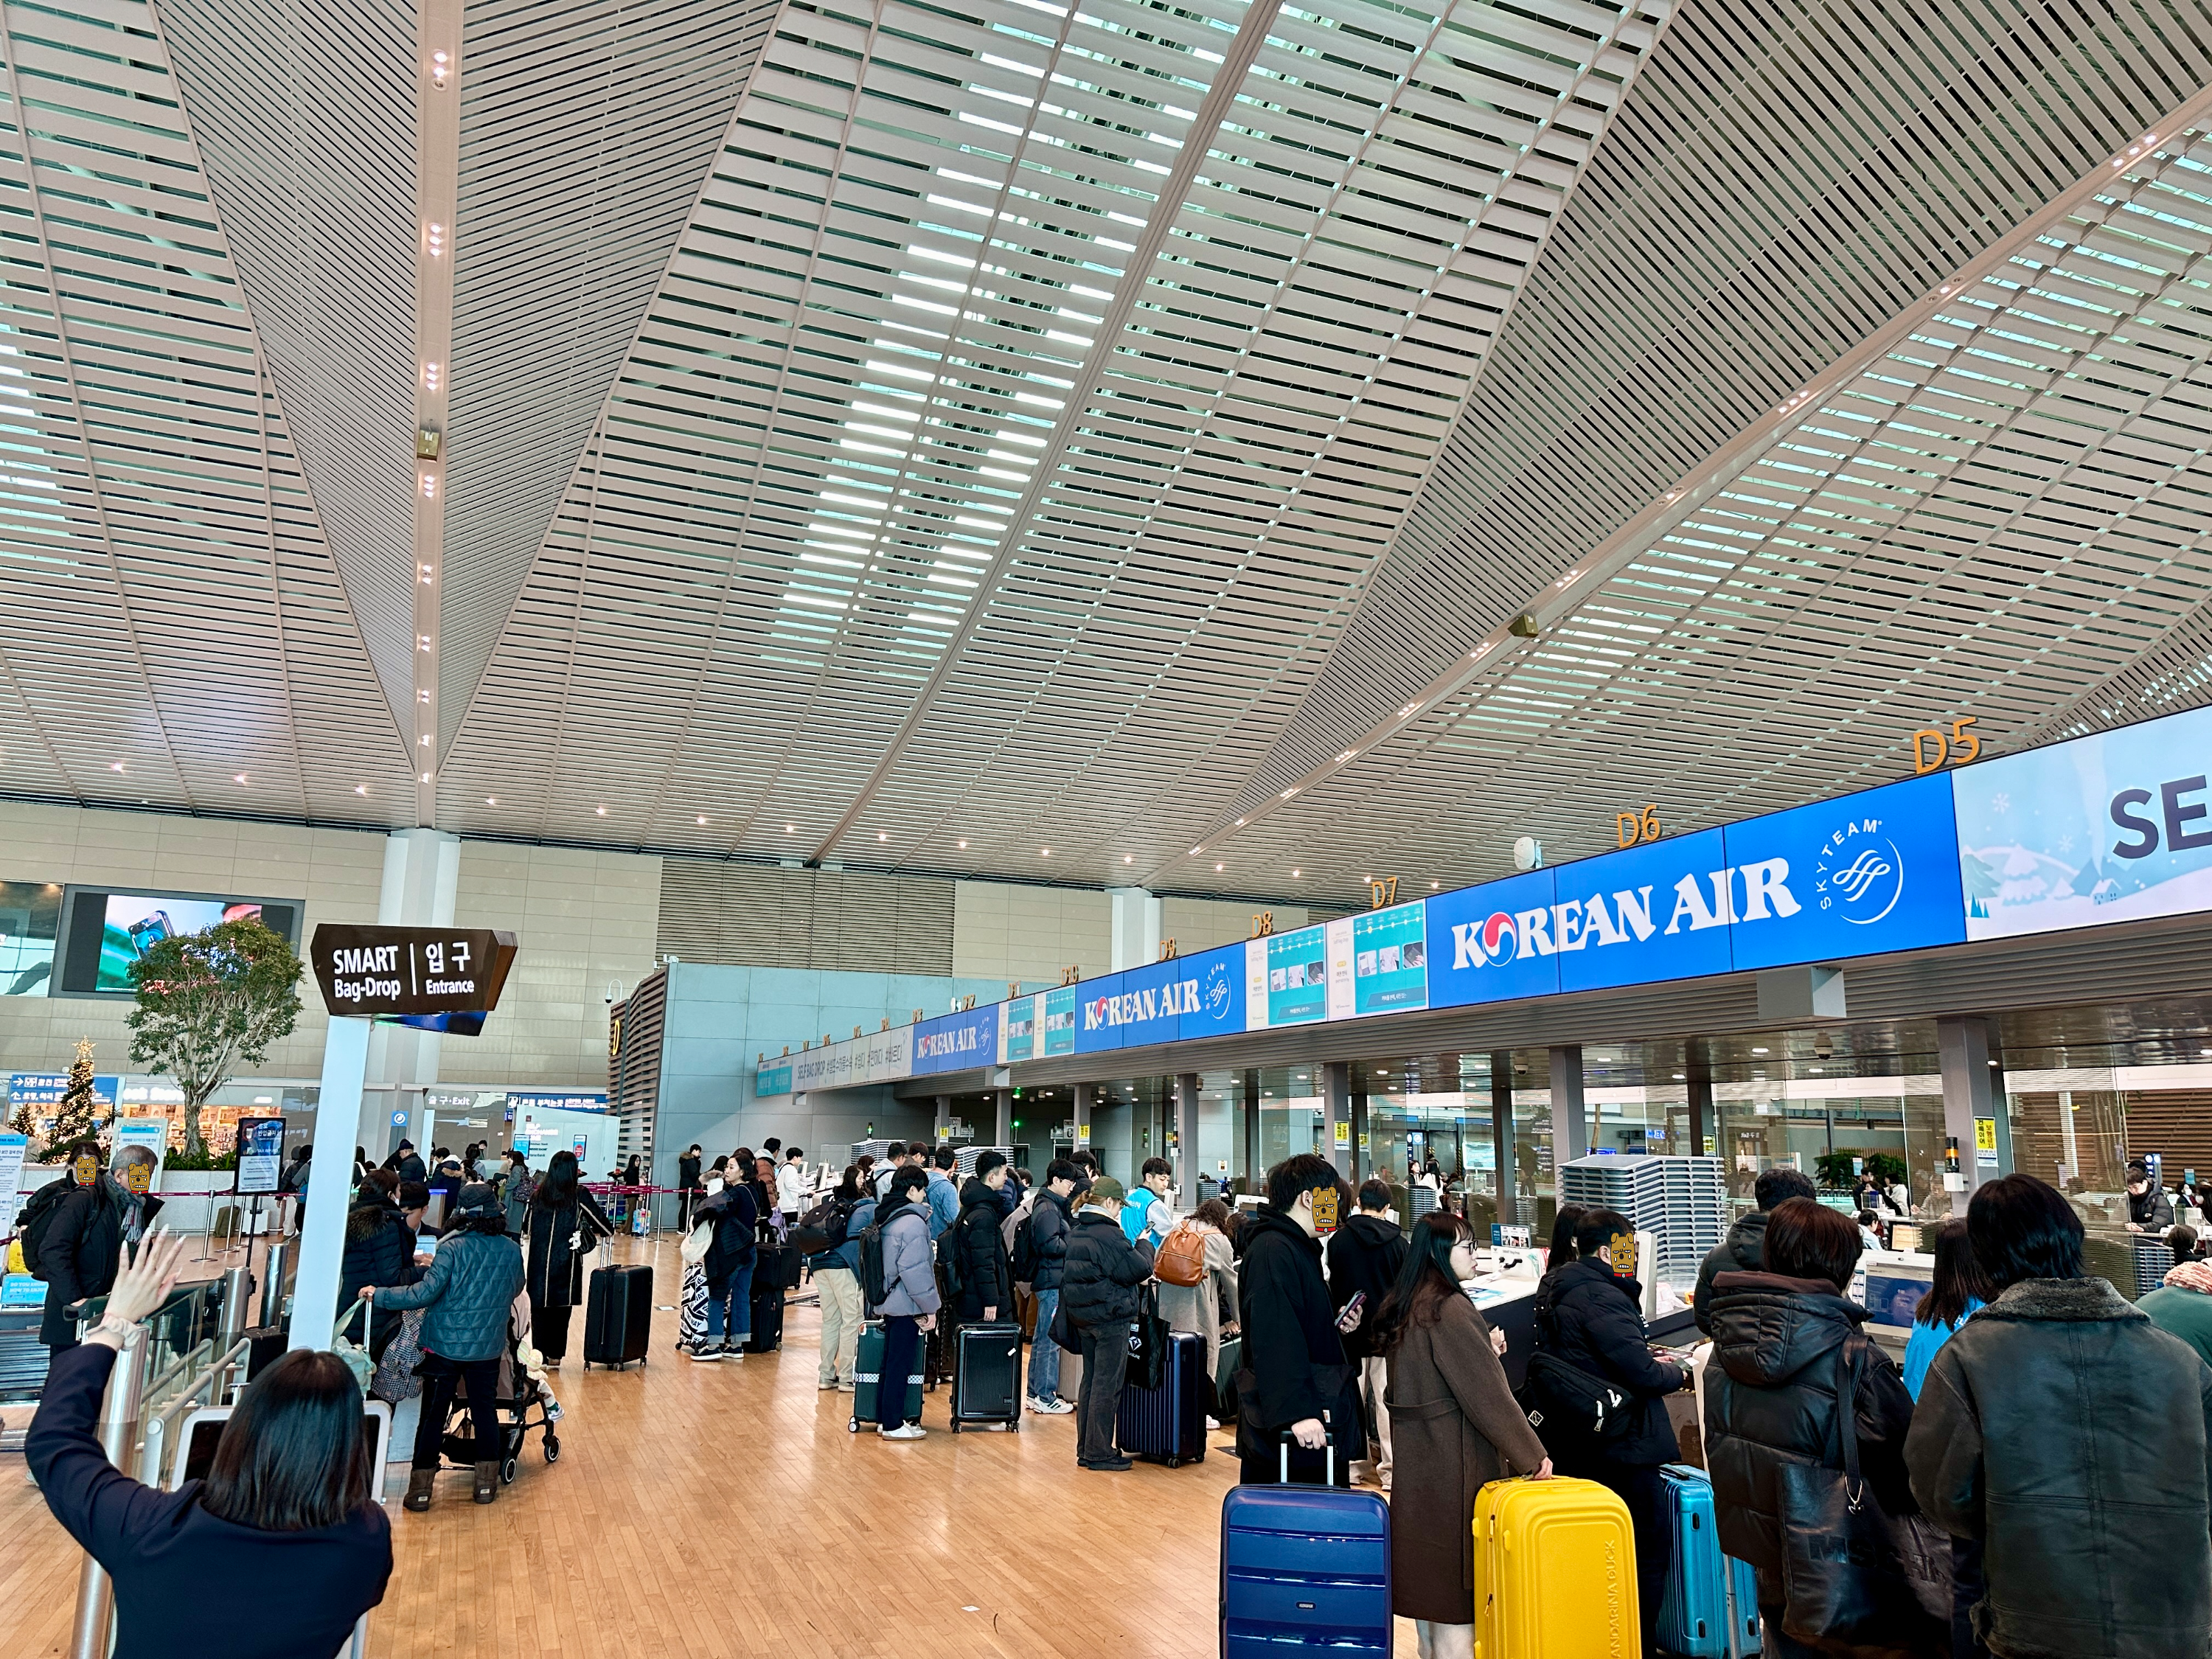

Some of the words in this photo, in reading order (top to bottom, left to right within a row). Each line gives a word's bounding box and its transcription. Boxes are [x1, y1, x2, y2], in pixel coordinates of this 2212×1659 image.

[1914, 717, 1982, 774] D5
[1618, 804, 1662, 848] D6
[2110, 775, 2212, 859] SE
[1816, 819, 1882, 910] SKYTEAM
[1372, 876, 1399, 909] D7
[1251, 911, 1273, 939] D8
[1451, 885, 1656, 970] KOREAN
[1664, 858, 1802, 935] AIR
[333, 945, 399, 975] SMART
[1160, 937, 1176, 961] D9
[334, 977, 401, 1002] Bag-Drop
[426, 978, 474, 995] Entrance
[1084, 988, 1156, 1030] KOREAN
[1158, 978, 1201, 1018] AIR
[613, 1020, 619, 1056] D
[917, 1031, 956, 1060] KOREAN
[956, 1026, 977, 1051] AIR
[798, 1064, 807, 1079] SELF
[806, 1062, 815, 1078] BAG
[815, 1060, 825, 1077] DROP
[1605, 1540, 1616, 1581] DUCK
[1607, 1583, 1621, 1659] ANDARINA
